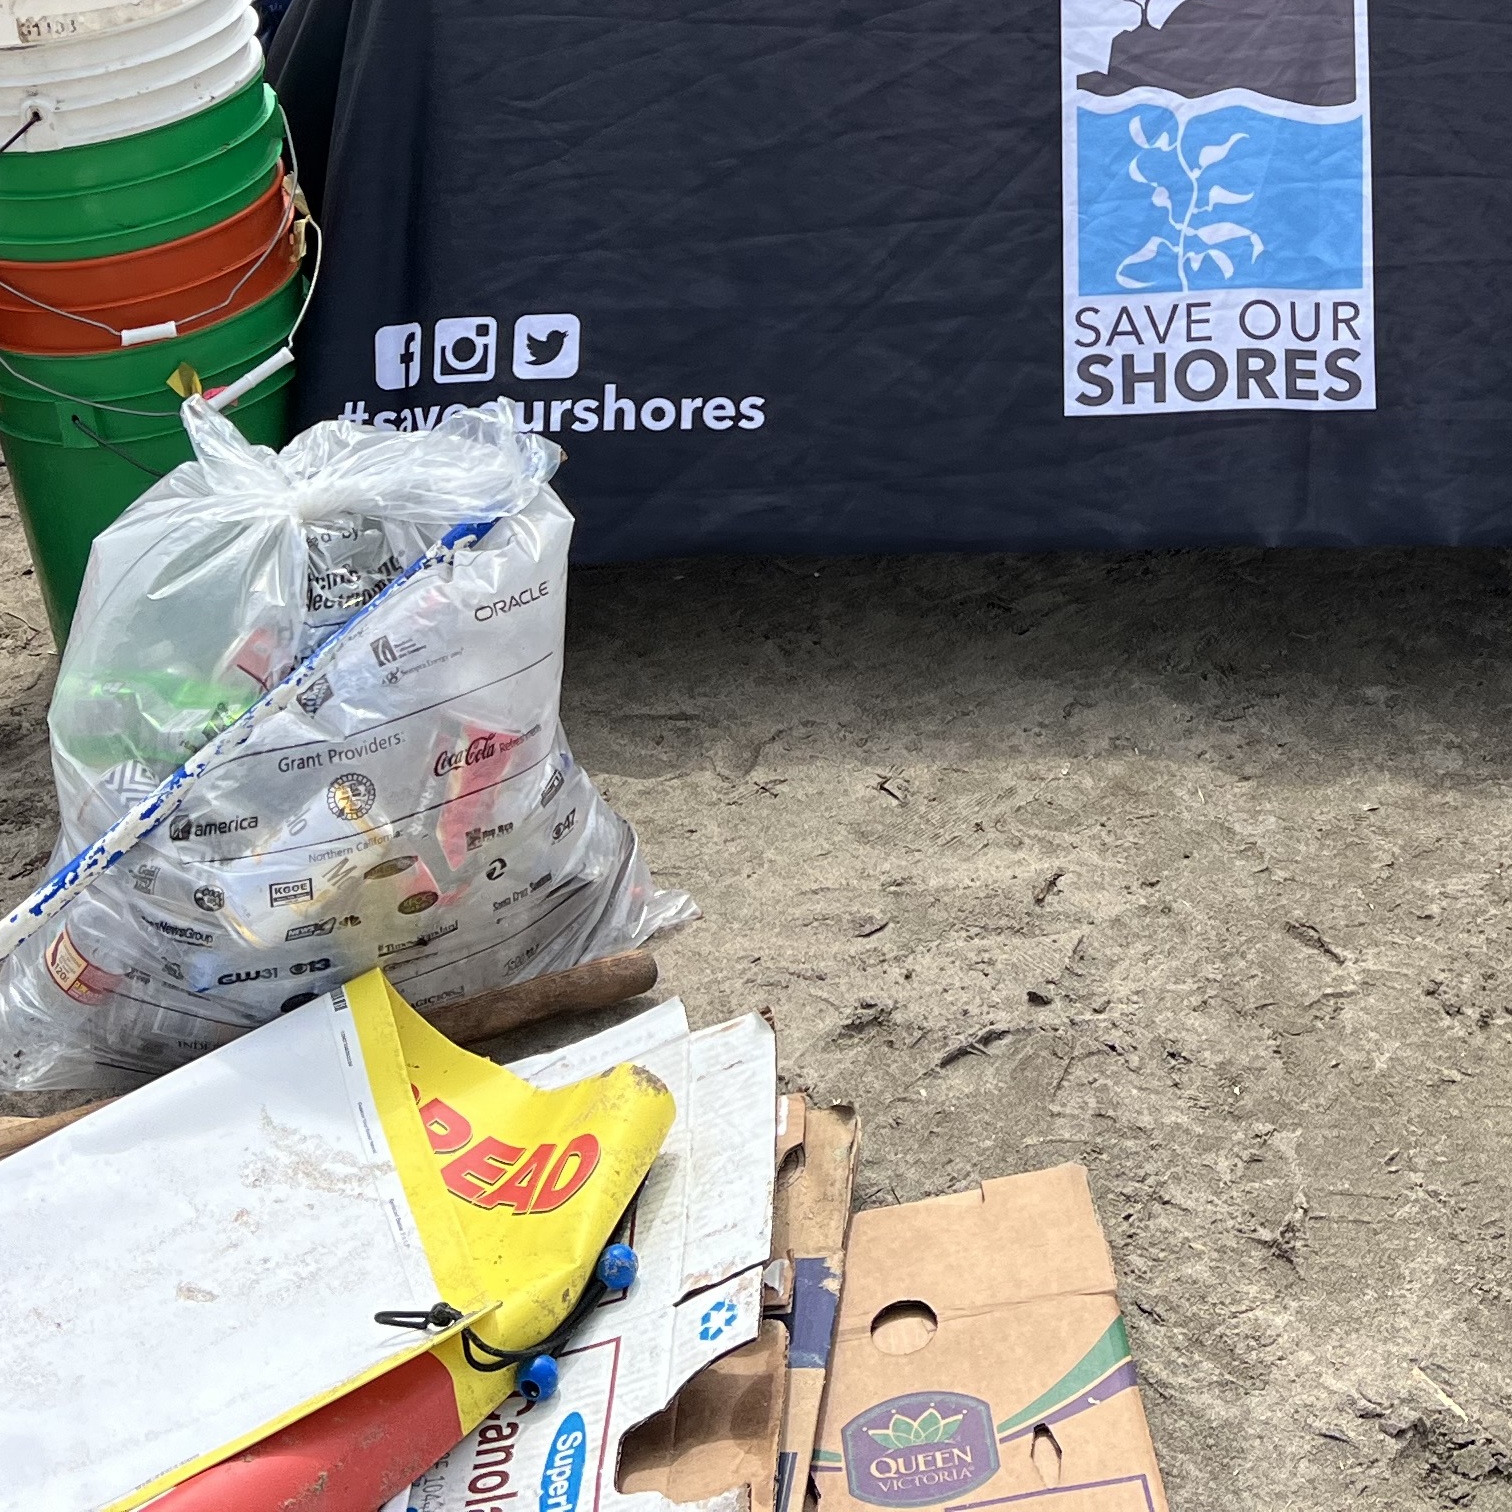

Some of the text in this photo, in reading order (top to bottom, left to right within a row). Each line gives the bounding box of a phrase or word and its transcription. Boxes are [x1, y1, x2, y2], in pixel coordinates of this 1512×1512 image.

[1074, 299, 1362, 348] SAVE OUR
[1074, 347, 1362, 407] SHORES
[474, 580, 549, 622] ORACLE
[277, 729, 406, 774] Grant Providers:
[193, 815, 259, 838] america
[308, 845, 354, 864] Northern
[464, 1390, 538, 1512] Canol
[546, 1430, 584, 1512] Super
[870, 1445, 973, 1480] QUEEN
